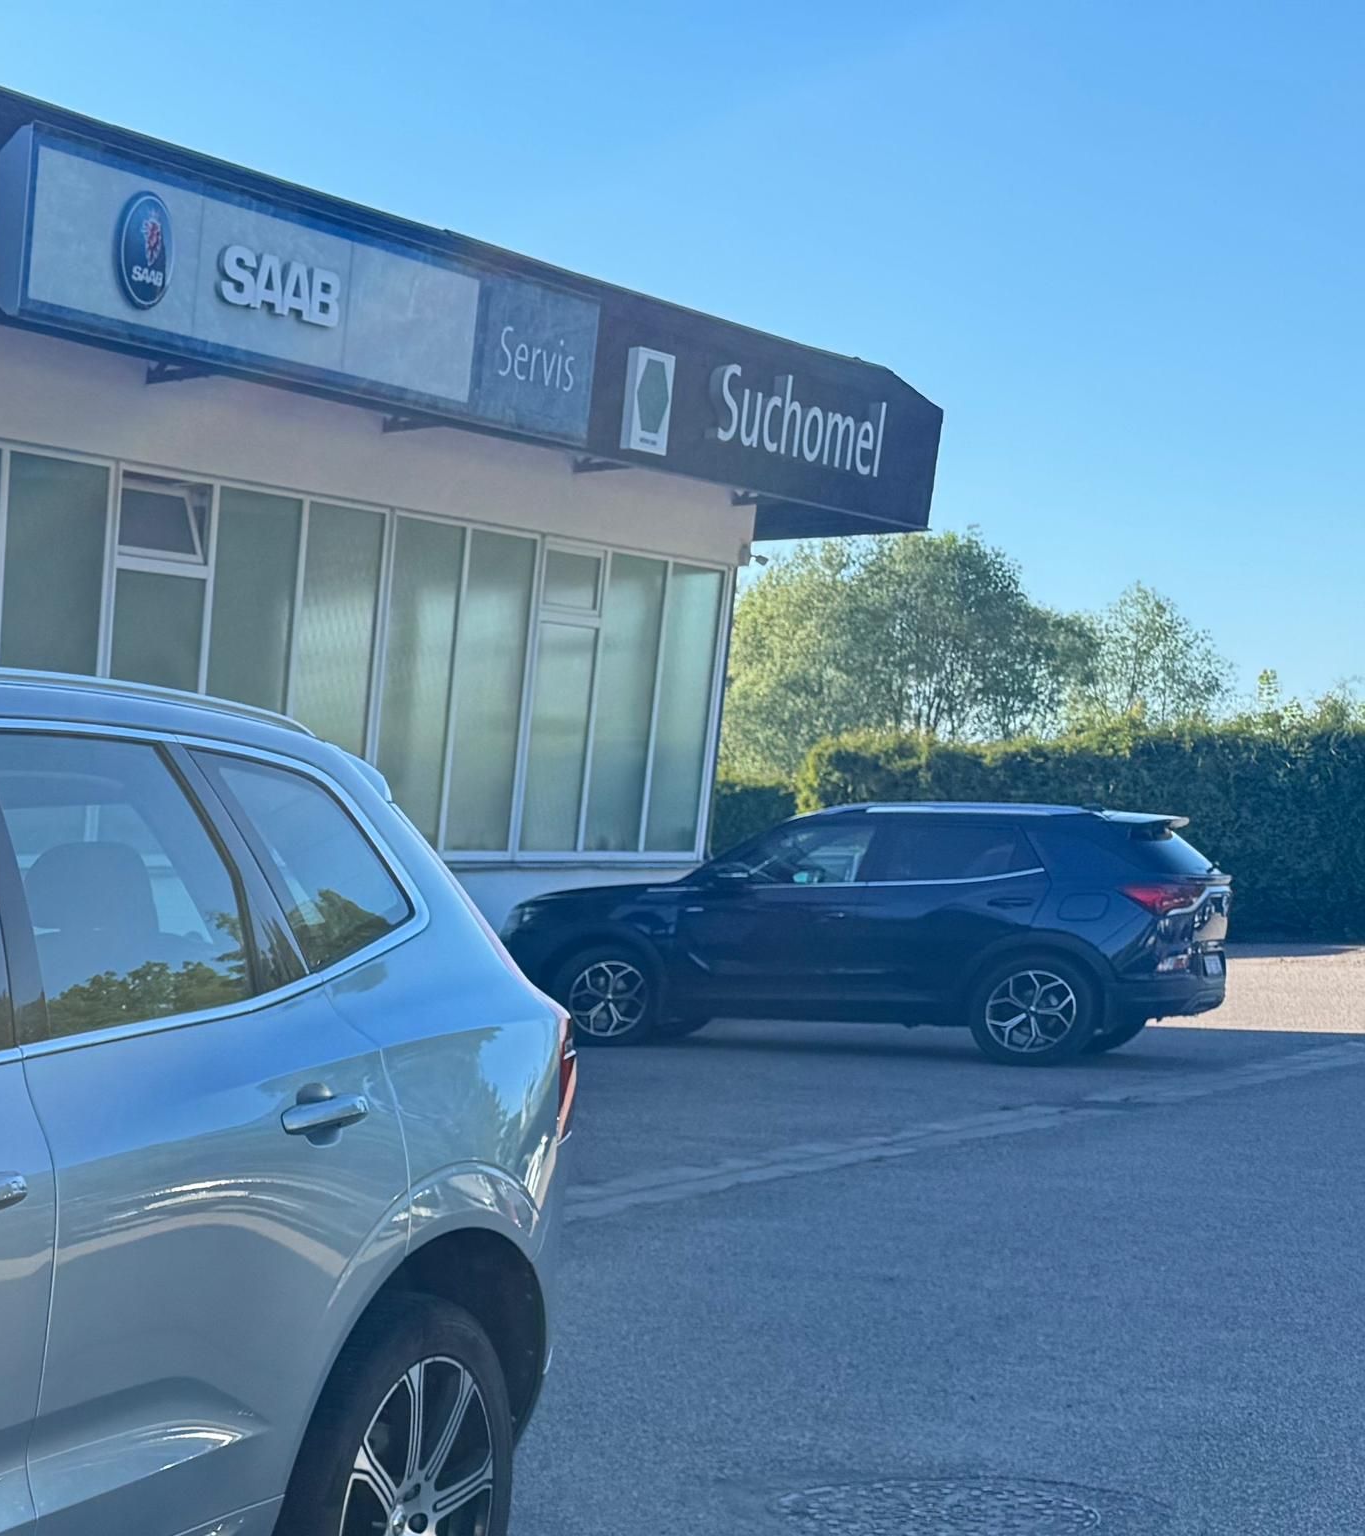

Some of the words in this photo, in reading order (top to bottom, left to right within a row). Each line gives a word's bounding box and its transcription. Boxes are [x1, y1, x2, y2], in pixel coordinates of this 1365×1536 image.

[131, 265, 164, 287] SAAB
[220, 245, 341, 328] SAAB
[497, 326, 575, 393] Servis
[713, 362, 888, 478] Suchomel
